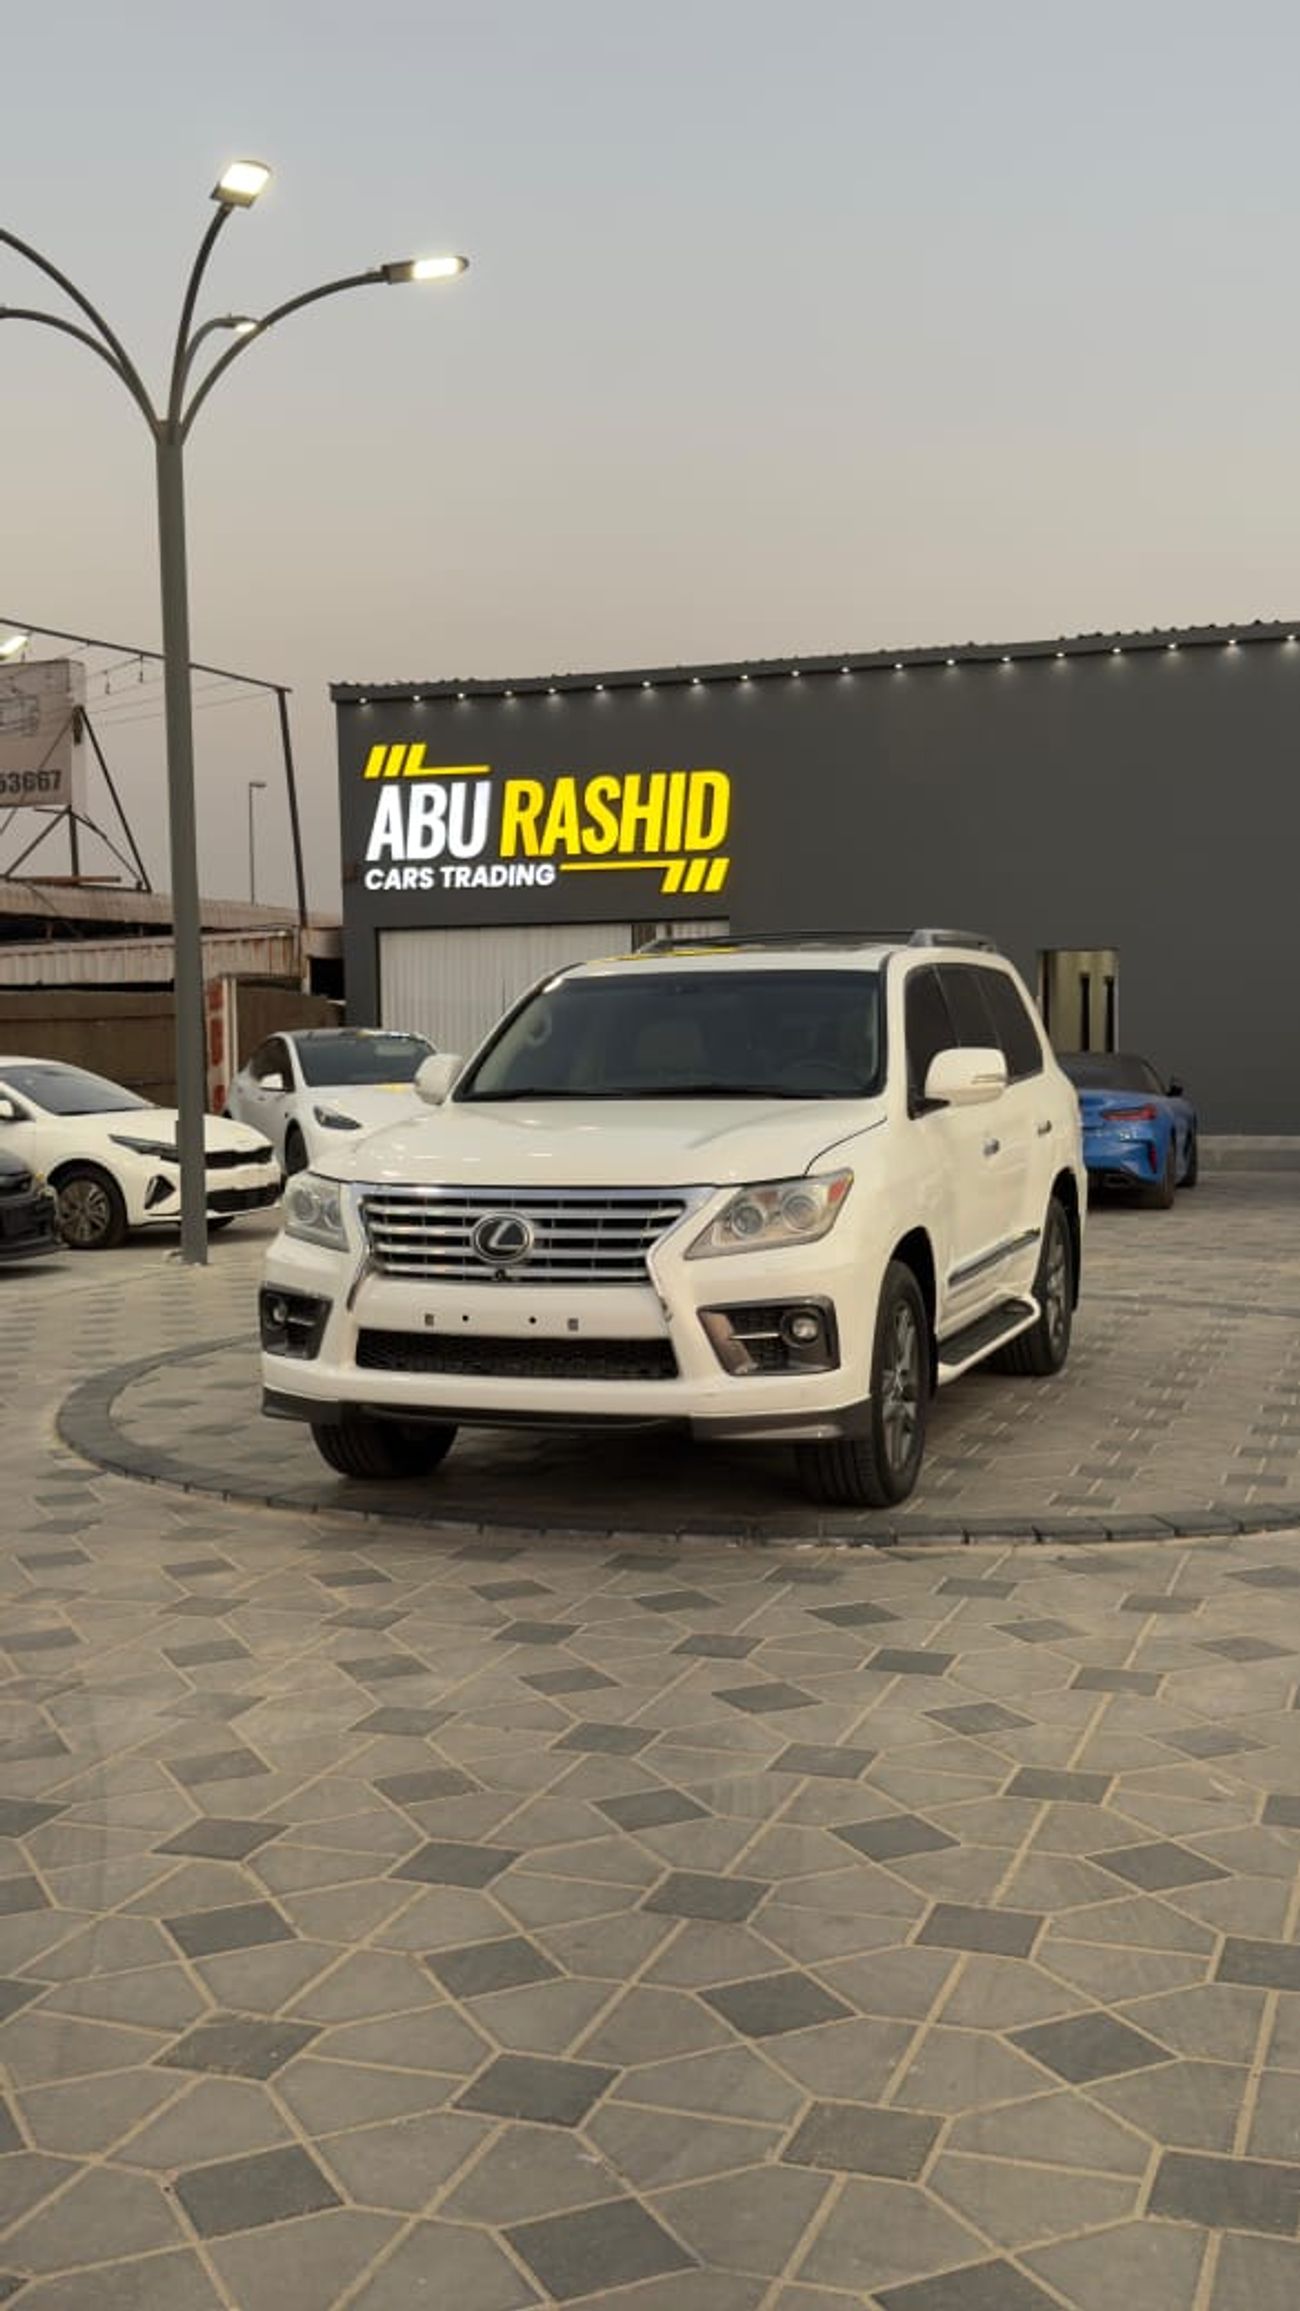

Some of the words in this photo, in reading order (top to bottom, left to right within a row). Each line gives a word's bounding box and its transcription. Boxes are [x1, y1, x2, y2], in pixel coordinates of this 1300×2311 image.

[365, 780, 492, 862] ABU
[499, 770, 731, 858] RASHID
[364, 866, 435, 891] CARS
[440, 863, 556, 889] TRADING
